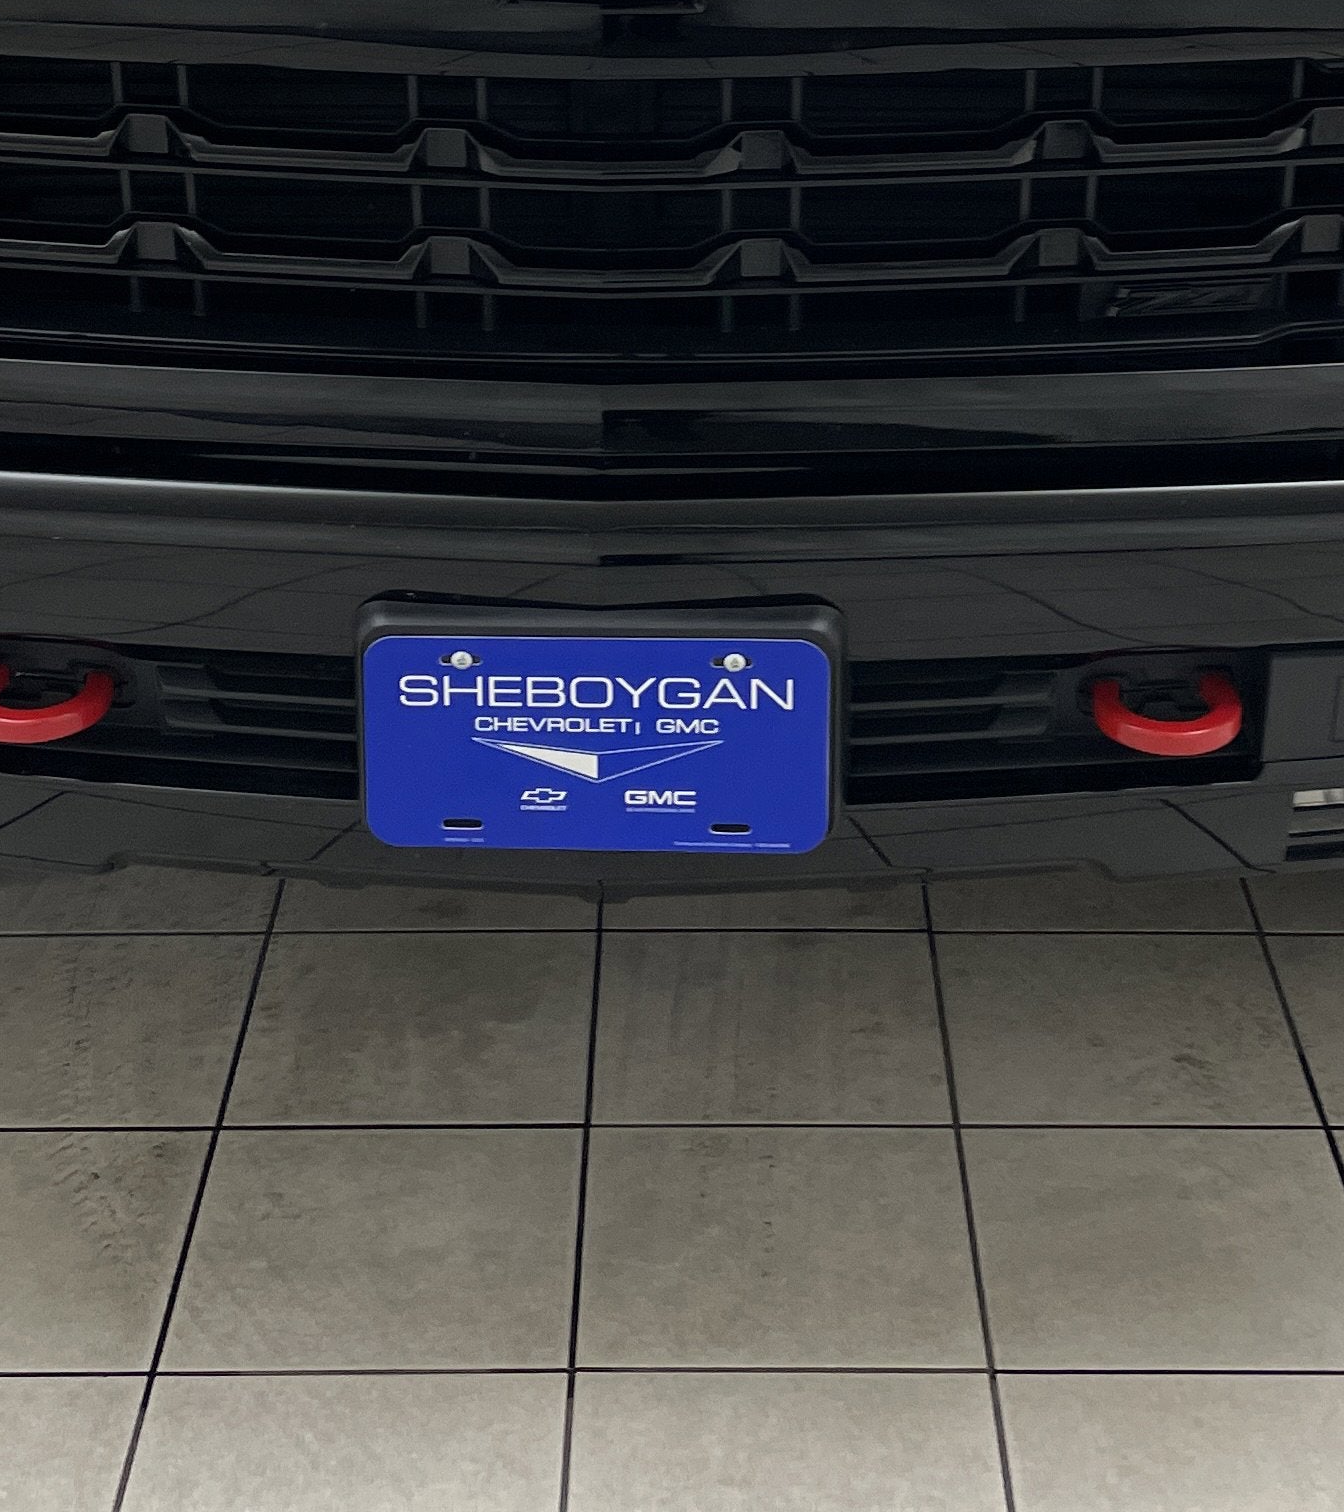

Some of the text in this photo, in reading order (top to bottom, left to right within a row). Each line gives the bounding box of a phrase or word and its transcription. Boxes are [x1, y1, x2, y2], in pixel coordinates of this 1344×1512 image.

[398, 674, 795, 712] SHEBOYGAN
[474, 716, 720, 736] CHEVROLET GMC
[624, 790, 697, 806] GMC
